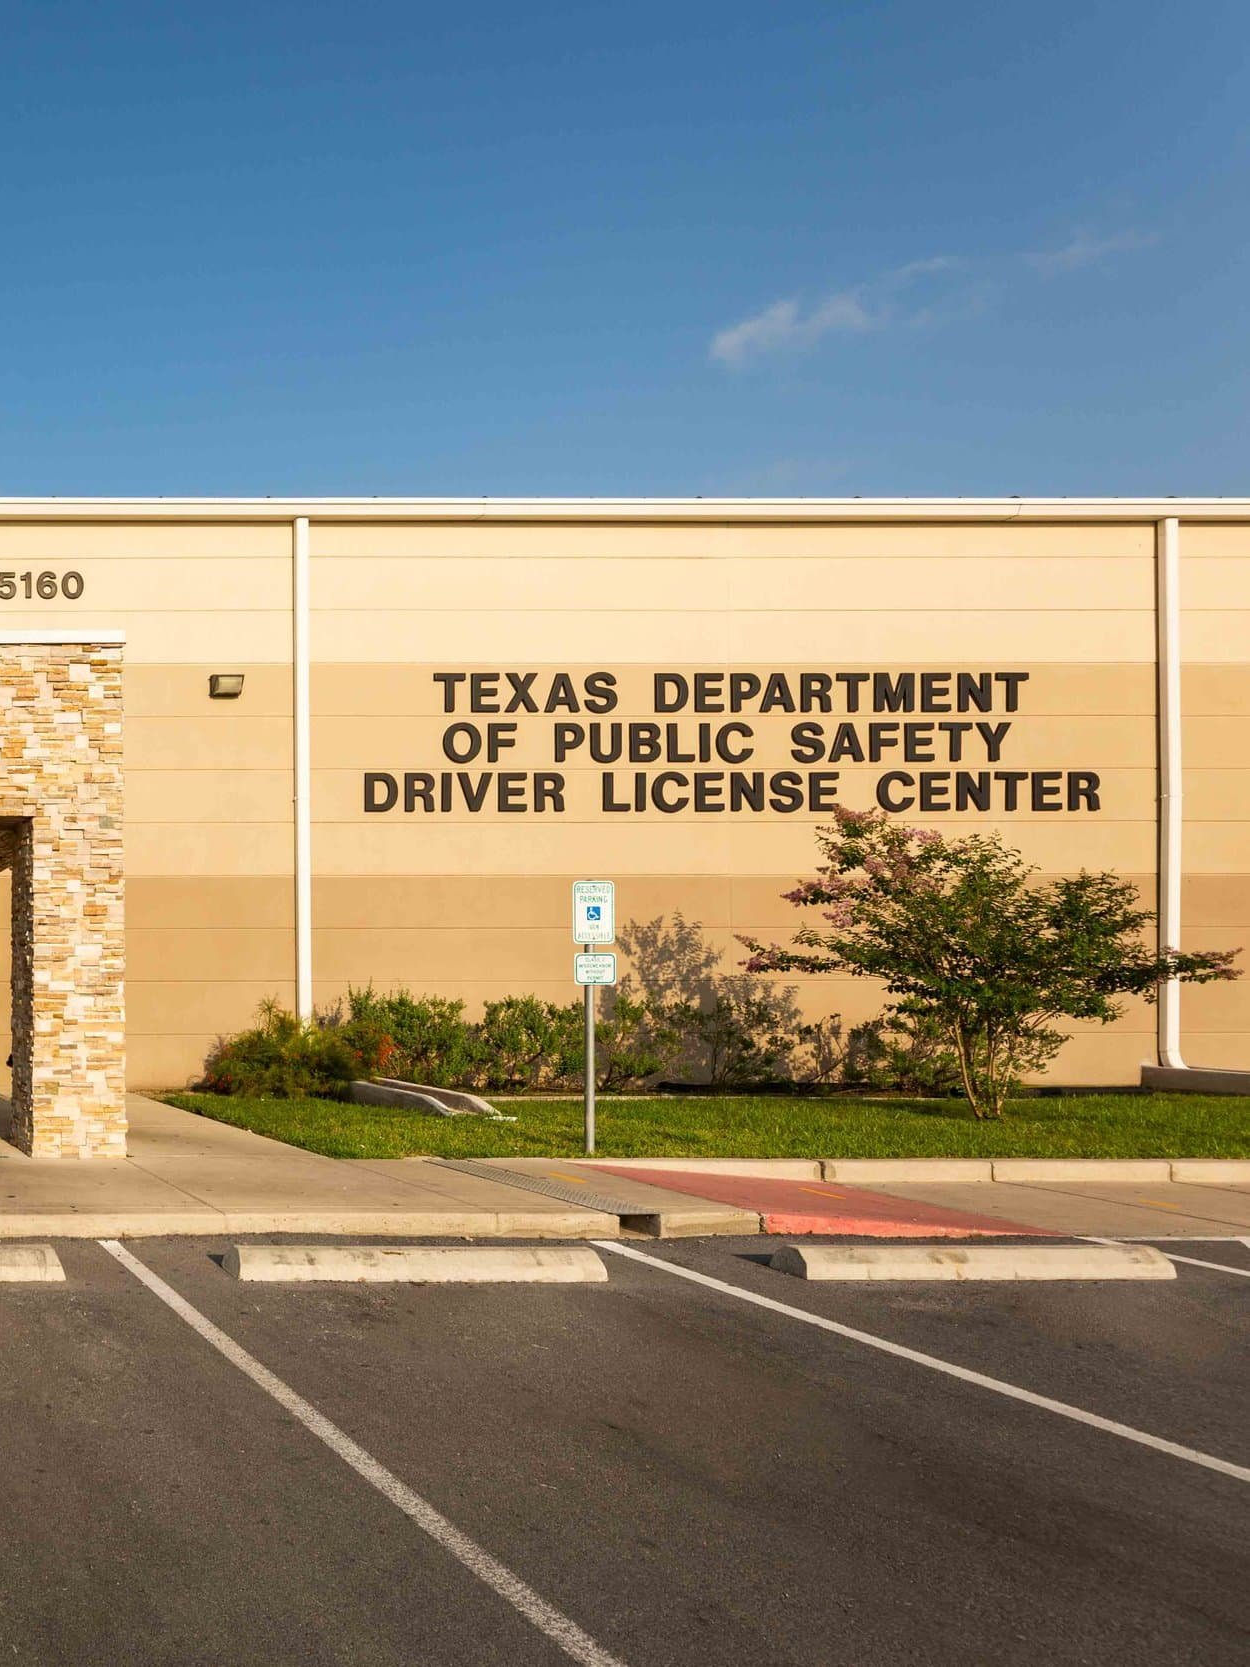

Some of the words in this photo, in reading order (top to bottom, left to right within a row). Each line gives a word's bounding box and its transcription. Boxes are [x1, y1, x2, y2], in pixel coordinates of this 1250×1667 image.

[433, 672, 618, 714] TEXAS
[654, 672, 1029, 713] DEPARTMENT
[442, 722, 518, 764] OF
[554, 722, 754, 764] PUBLIC
[791, 722, 1012, 764] SAFETY
[364, 772, 566, 813] DRIVER
[602, 771, 840, 814] LICENSE
[876, 771, 1101, 813] CENTER
[576, 885, 610, 894] RESERVED
[579, 895, 608, 903] PARKING
